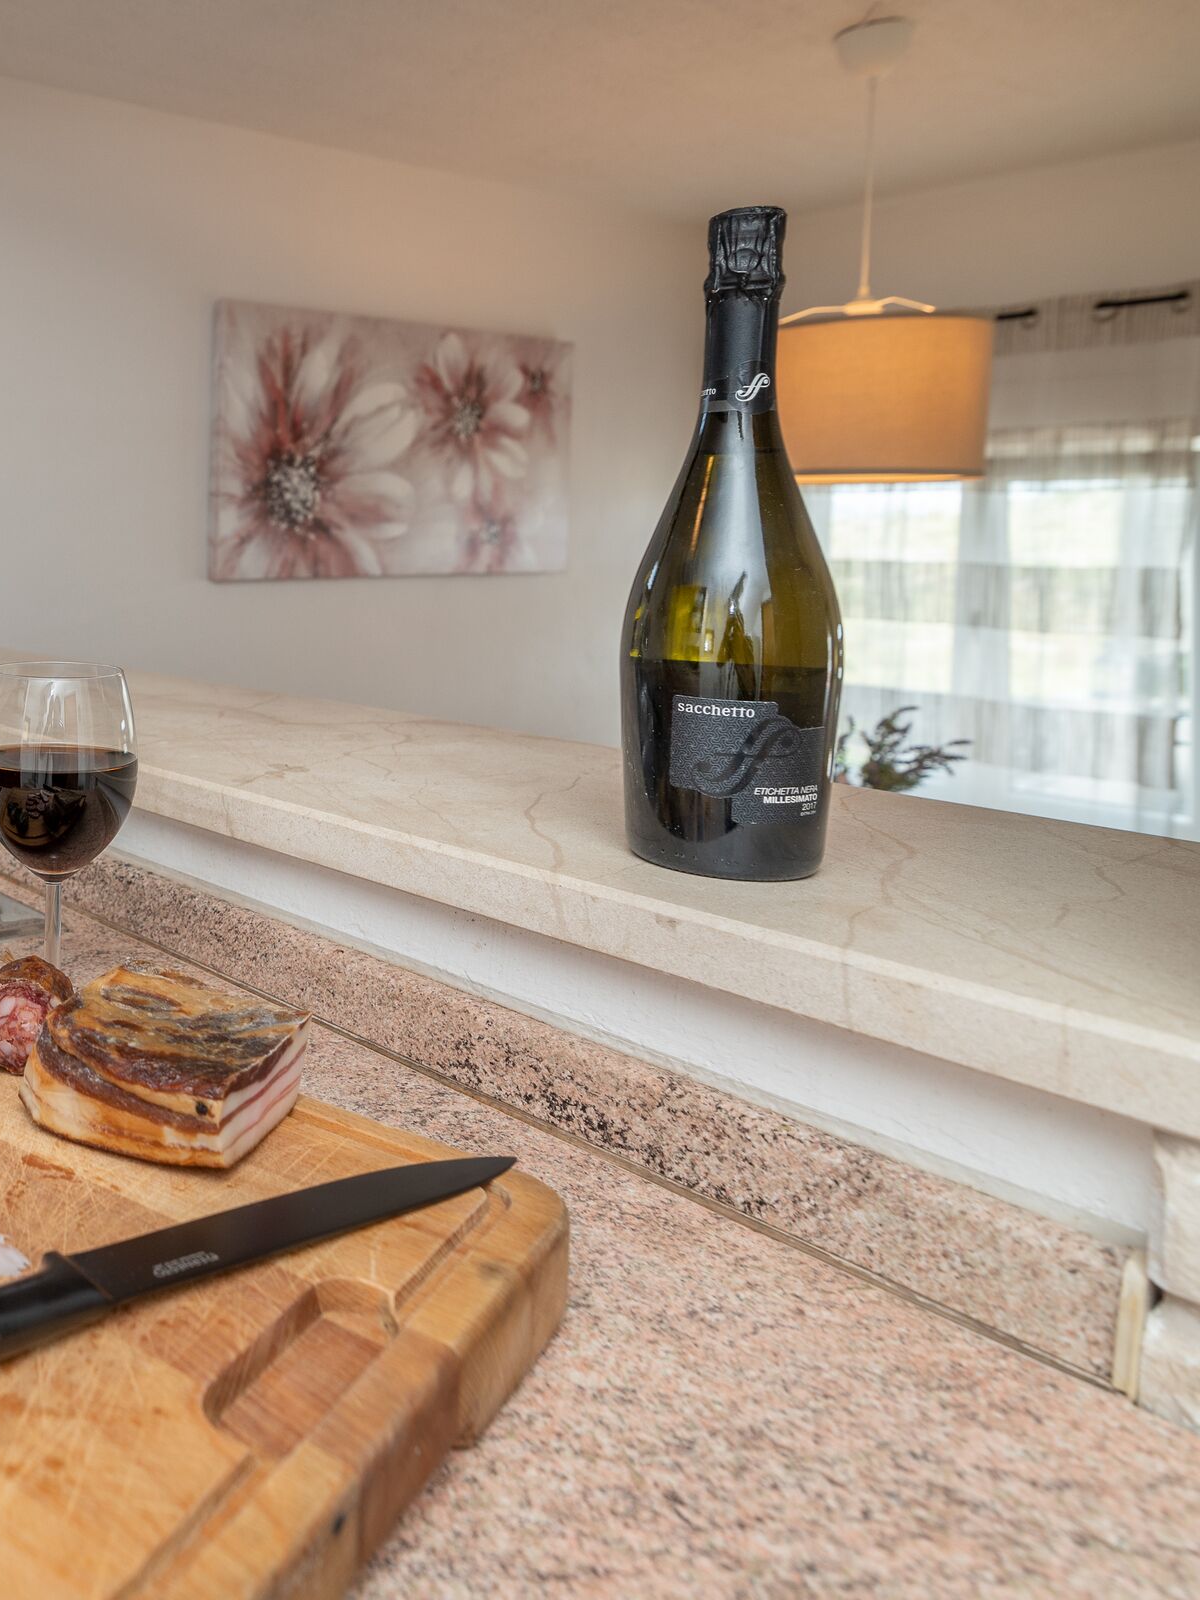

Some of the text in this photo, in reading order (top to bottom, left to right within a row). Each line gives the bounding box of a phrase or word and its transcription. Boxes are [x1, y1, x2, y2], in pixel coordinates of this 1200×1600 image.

[677, 702, 755, 718] sacchetto
[754, 784, 818, 796] ETICHETTA NERA
[763, 793, 818, 804] MILLESIMATO
[801, 801, 817, 811] 2017
